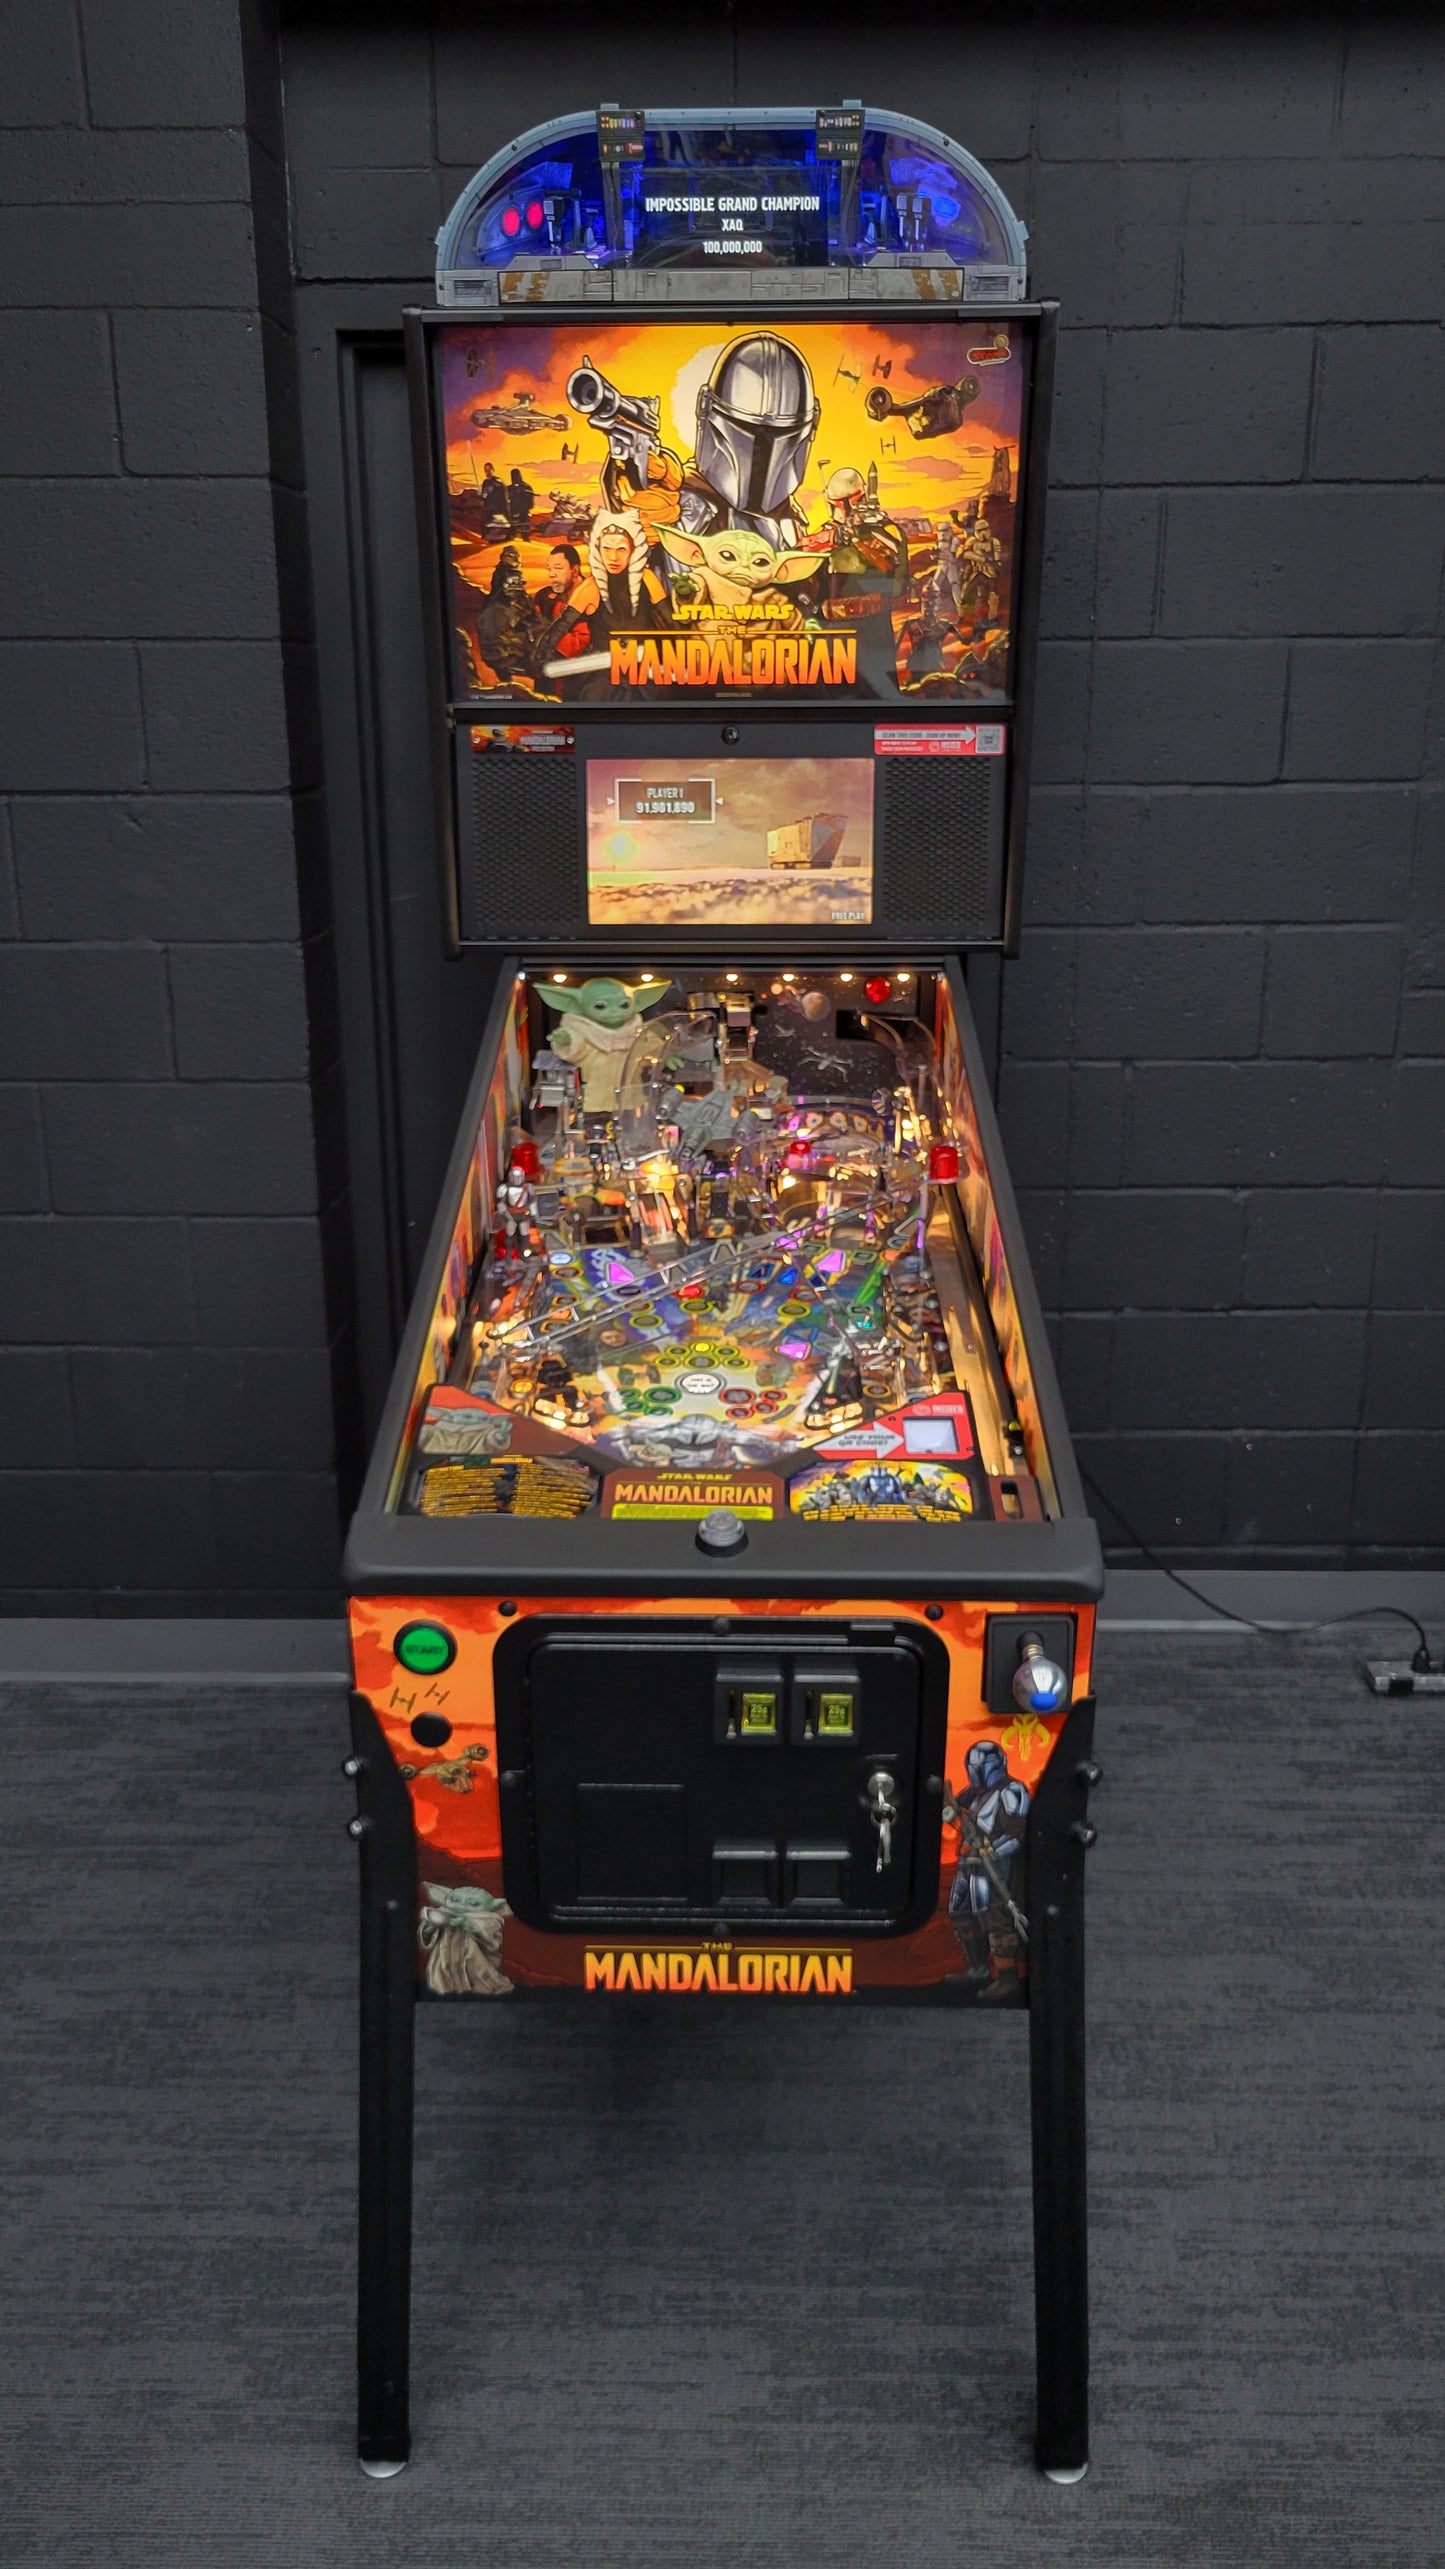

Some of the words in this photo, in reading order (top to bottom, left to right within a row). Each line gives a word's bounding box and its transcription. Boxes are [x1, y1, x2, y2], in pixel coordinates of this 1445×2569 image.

[645, 197, 715, 212] IMPOSSIBLE
[718, 197, 758, 212] GRAND
[761, 196, 820, 211] CHAMPION
[721, 218, 744, 231] XAQ
[702, 240, 763, 255] 100,000,000
[671, 604, 733, 621] STAR
[733, 603, 795, 620] WARS
[718, 625, 747, 634] THE
[609, 638, 857, 685] MANDALORIAN
[646, 787, 678, 798] PLAYER
[679, 787, 684, 798] 1
[656, 1472, 695, 1480] STAR
[695, 1473, 733, 1481] WARS
[614, 1483, 773, 1504] MANDALORIAN
[405, 1644, 444, 1655] START
[702, 1942, 734, 1951] THE
[585, 1952, 853, 1993] MANDALORIAN
